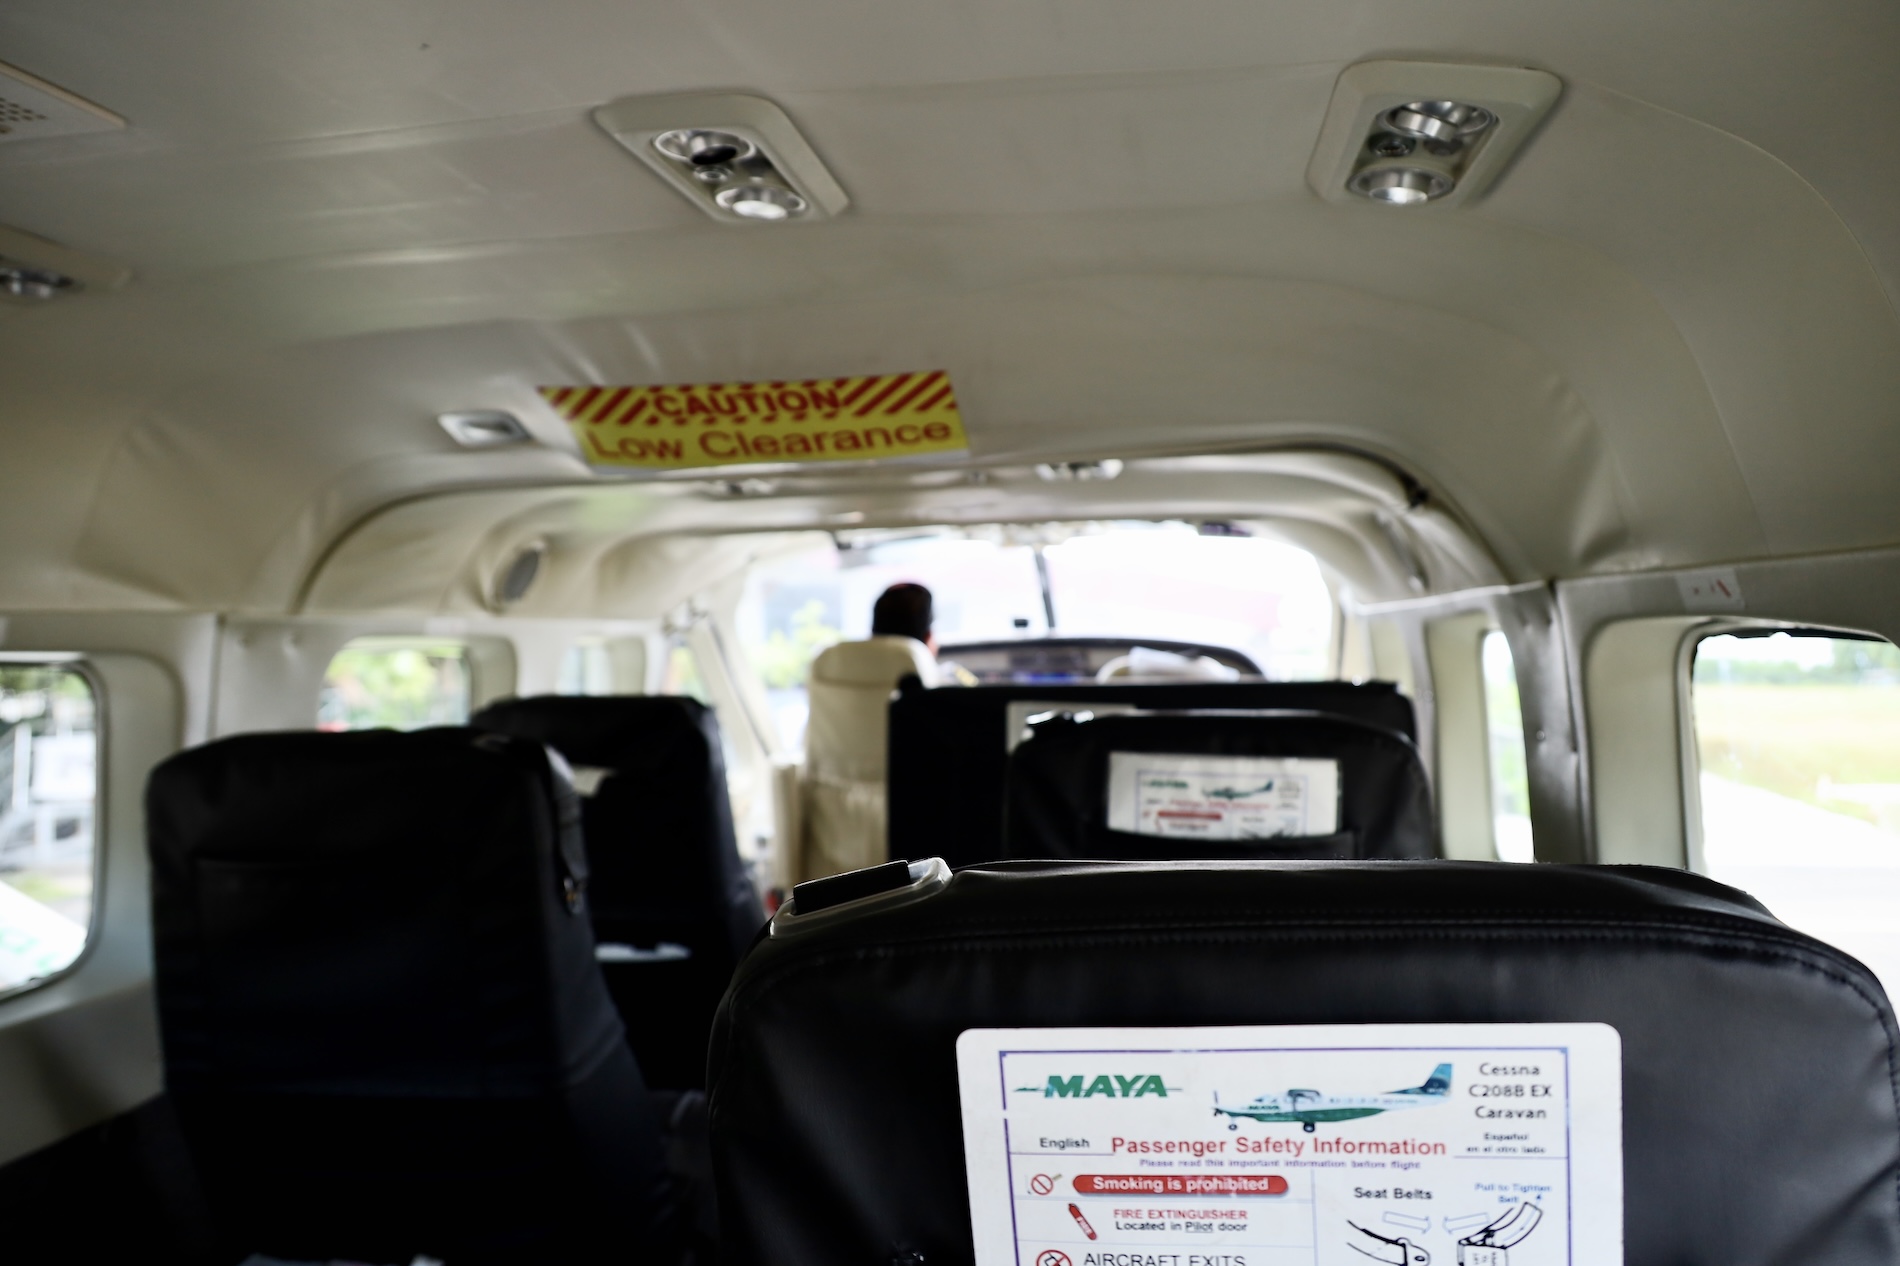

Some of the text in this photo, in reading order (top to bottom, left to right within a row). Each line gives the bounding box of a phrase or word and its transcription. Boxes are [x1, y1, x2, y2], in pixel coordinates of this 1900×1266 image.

[653, 385, 844, 419] CAUTION
[588, 421, 951, 461] Low Clearance
[1479, 1062, 1540, 1076] Cessna
[1044, 1075, 1168, 1098] MAYA
[1468, 1084, 1553, 1097] C208B EX
[1475, 1105, 1547, 1119] Caravan
[1039, 1137, 1090, 1149] English
[1111, 1136, 1446, 1157] Passenger Safety Information
[1205, 1159, 1224, 1167] this
[1229, 1159, 1279, 1169] important
[1284, 1160, 1346, 1168] information
[1391, 1161, 1420, 1170] flight
[1093, 1178, 1269, 1193] Smoking is prohibited
[1354, 1187, 1432, 1199] Seat Belts
[1114, 1209, 1248, 1219] FIRE EXTINGUISHER
[1115, 1221, 1247, 1232] Located in Pilot door
[1083, 1253, 1246, 1266] AIRCRAFT EXITS
